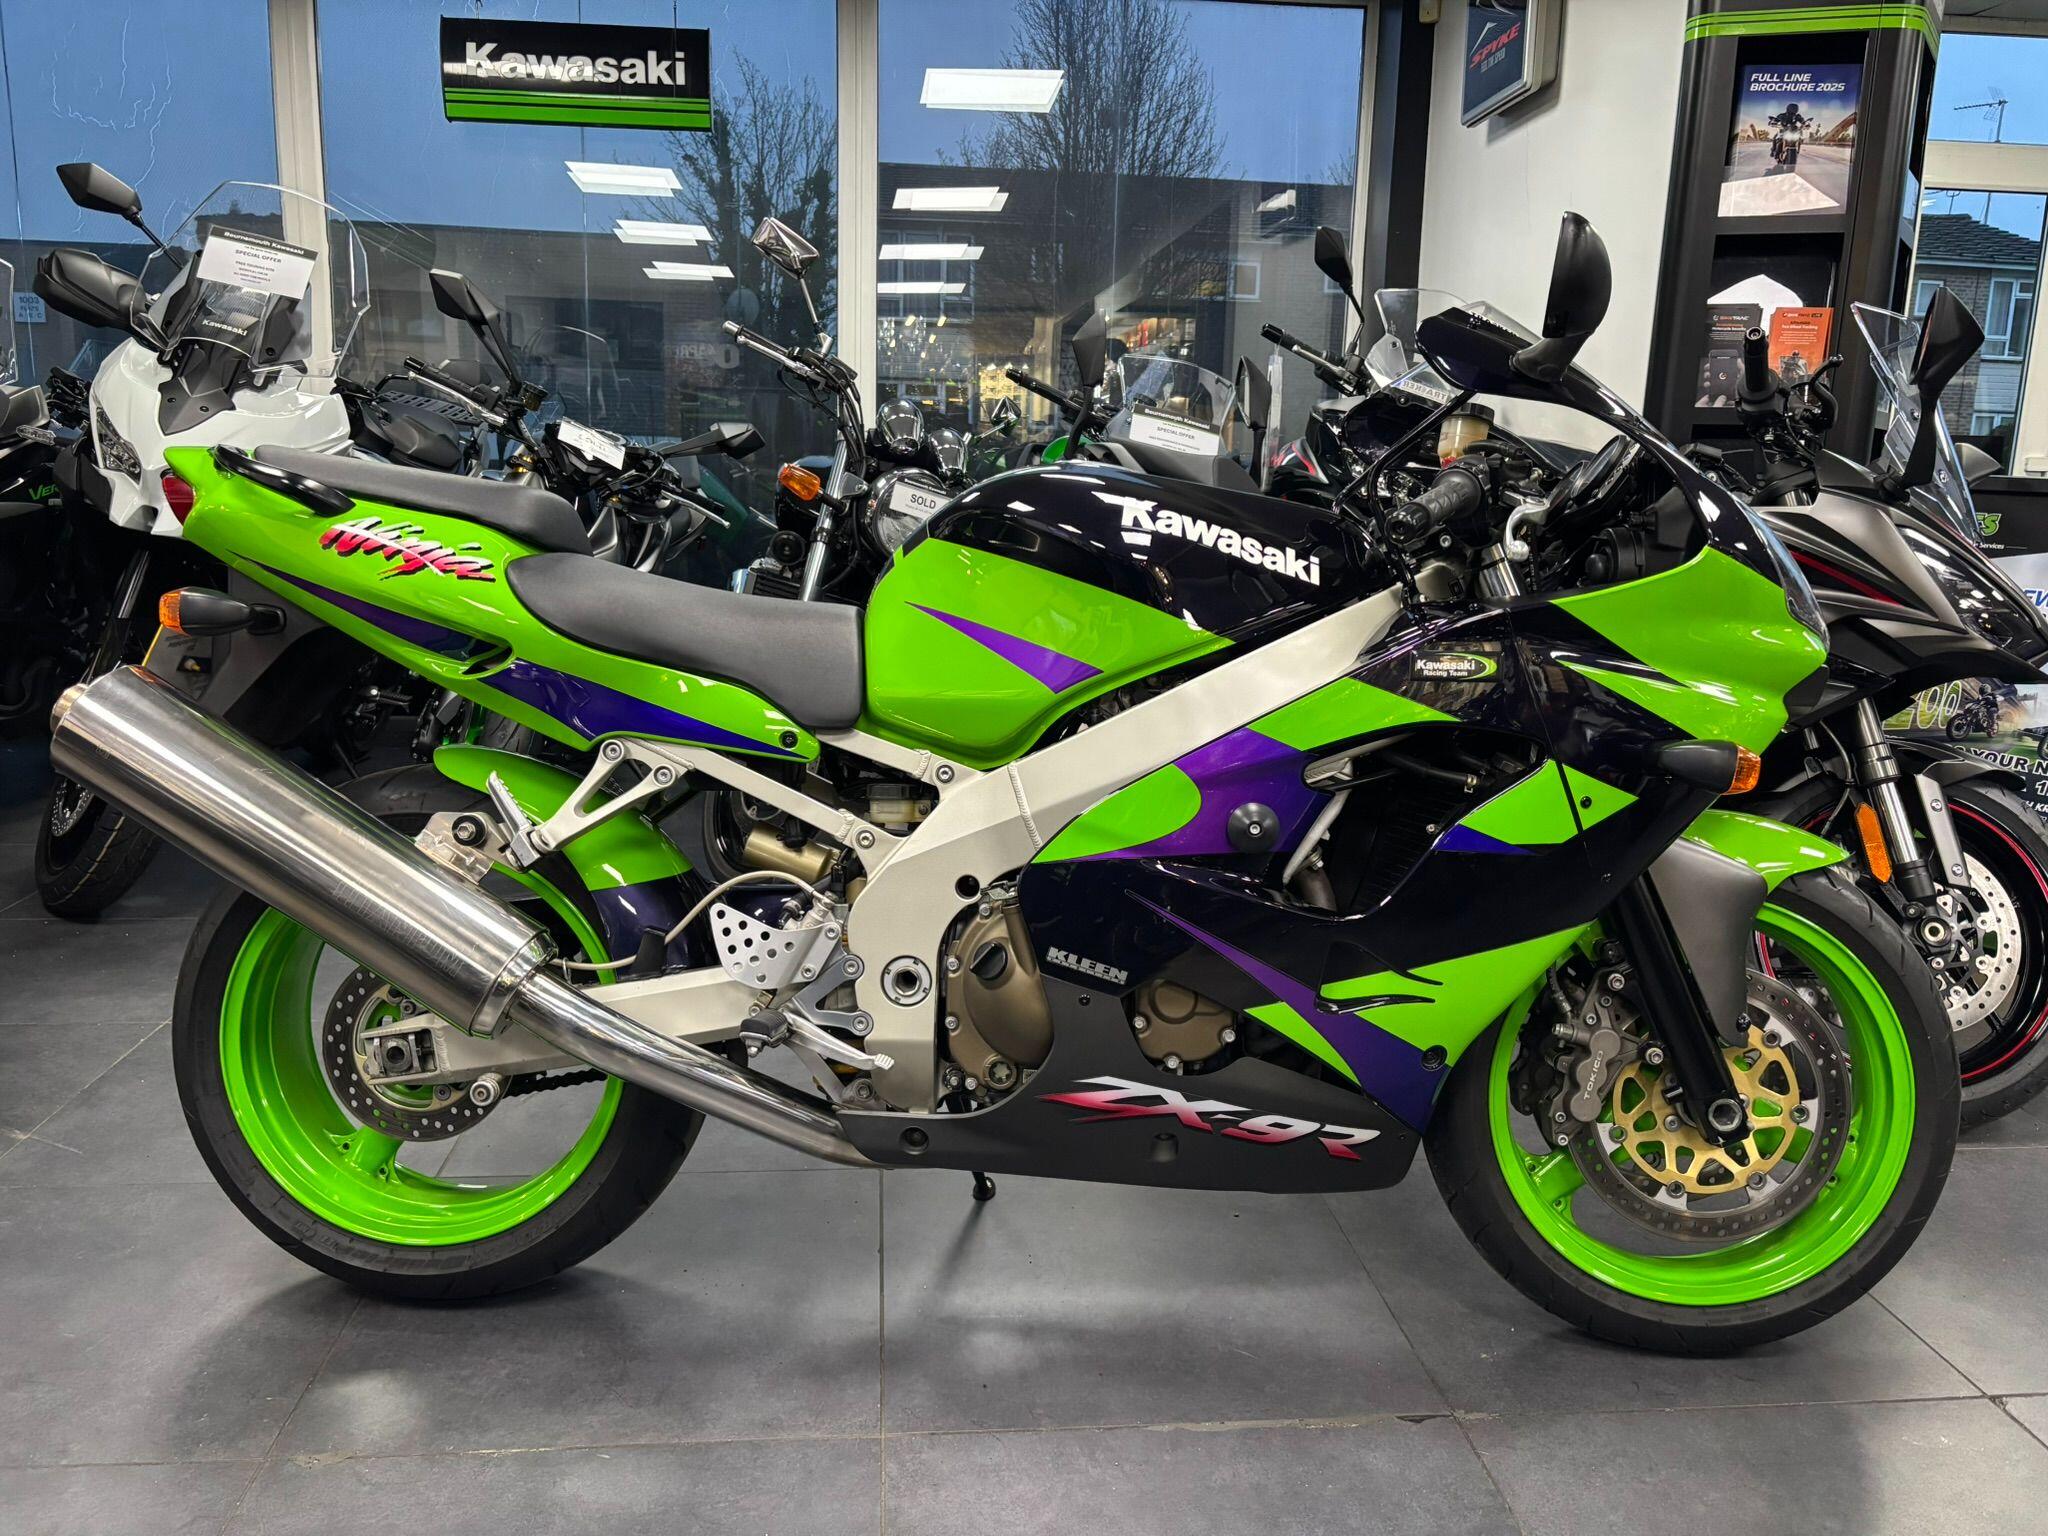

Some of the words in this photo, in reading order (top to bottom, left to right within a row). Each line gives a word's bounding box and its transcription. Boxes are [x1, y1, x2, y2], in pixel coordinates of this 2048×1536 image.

[465, 41, 686, 86] Kawasaki
[1750, 73, 1780, 82] FULL
[1783, 73, 1812, 82] LINE
[1749, 82, 1815, 92] BROCHURE
[1815, 82, 1846, 92] 2025
[235, 249, 261, 259] SPECIAL
[261, 254, 282, 263] OFFER
[271, 240, 305, 255] Kawasaki
[202, 319, 248, 337] Kawasaki
[1157, 426, 1178, 436] SPECIAL
[1178, 430, 1196, 440] OFFER
[909, 493, 937, 510] SOLD
[319, 516, 497, 583] Ninja
[1120, 496, 1320, 587] Kawasaki
[1416, 659, 1476, 670] Kawasaki
[1423, 669, 1447, 677] Racing
[1449, 669, 1468, 677] Team
[1970, 747, 2029, 773] YOUR
[1047, 946, 1129, 983] KLEEN
[1583, 1050, 1604, 1100] TOKICO
[1038, 1075, 1382, 1161] ZX-9R
